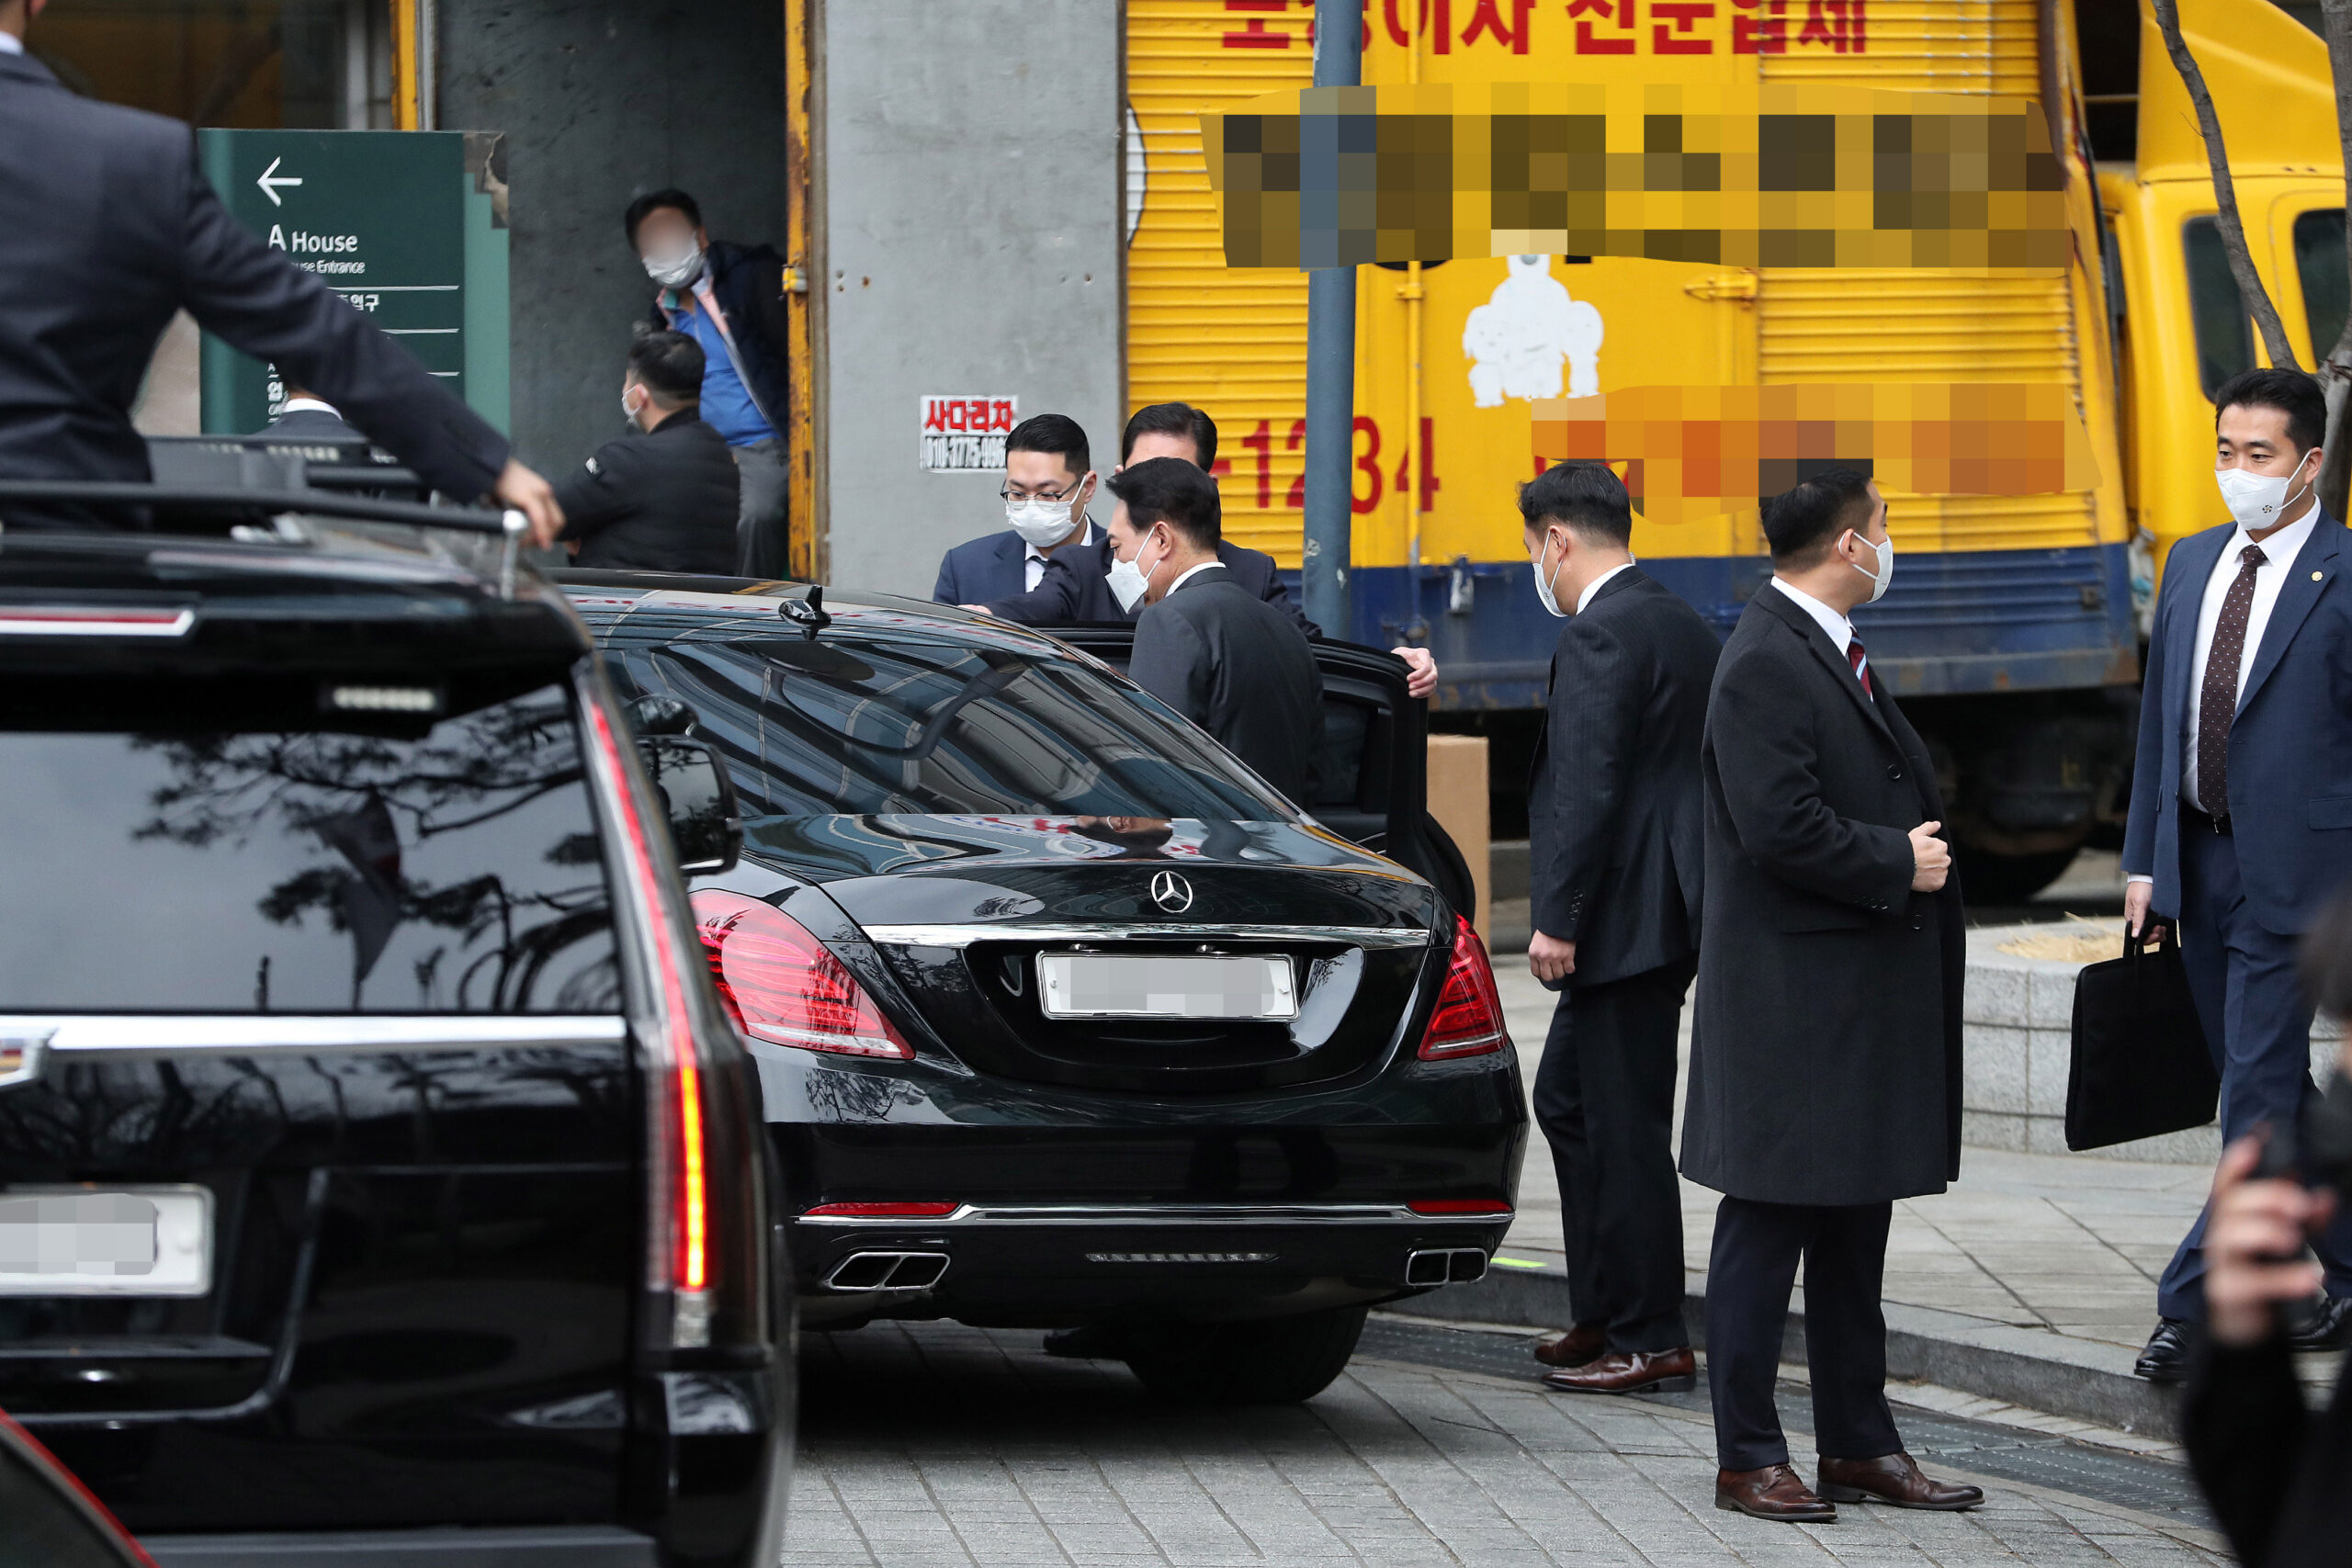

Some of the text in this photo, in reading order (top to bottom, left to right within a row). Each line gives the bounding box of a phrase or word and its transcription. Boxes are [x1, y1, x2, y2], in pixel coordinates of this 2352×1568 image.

[268, 224, 358, 253] A House
[316, 259, 366, 274] Entrance
[924, 400, 1014, 433] 사다리차
